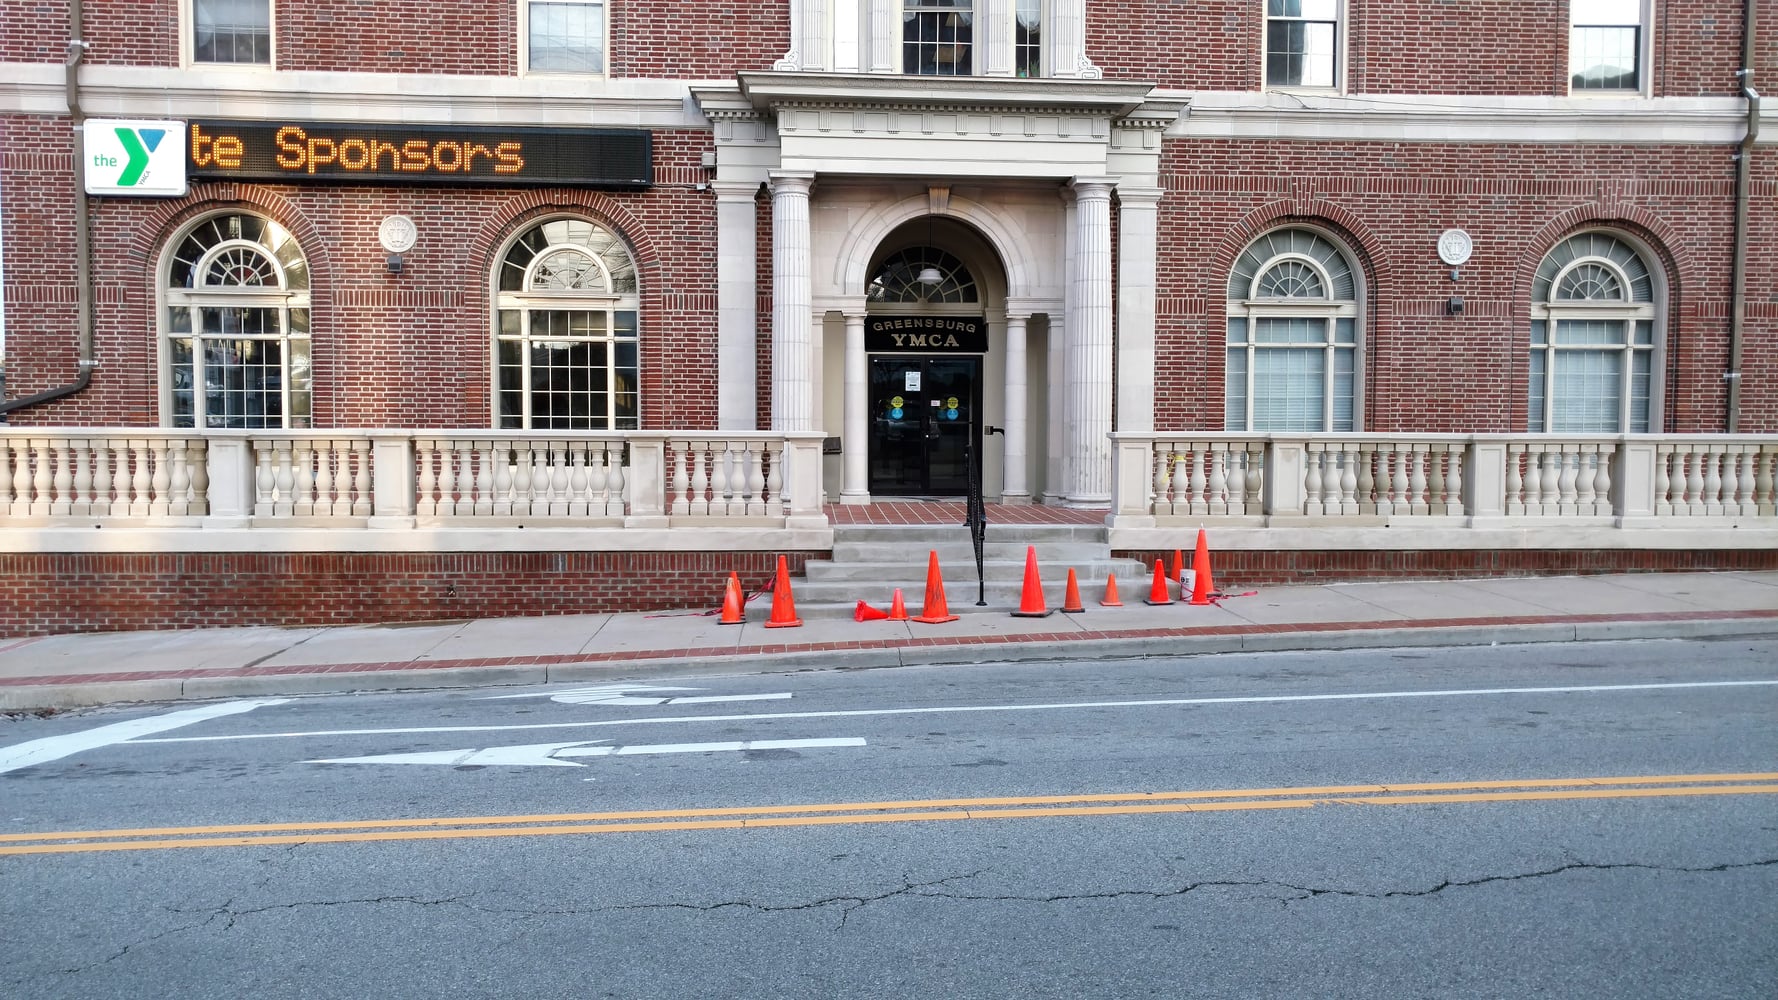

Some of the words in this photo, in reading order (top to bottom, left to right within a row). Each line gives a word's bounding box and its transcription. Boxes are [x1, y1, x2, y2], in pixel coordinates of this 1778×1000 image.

[191, 123, 243, 168] te
[275, 125, 525, 175] Sponsors
[94, 154, 117, 167] the
[138, 170, 151, 185] YMCA
[873, 319, 976, 333] GREENSBURG
[891, 333, 960, 347] YMCA
